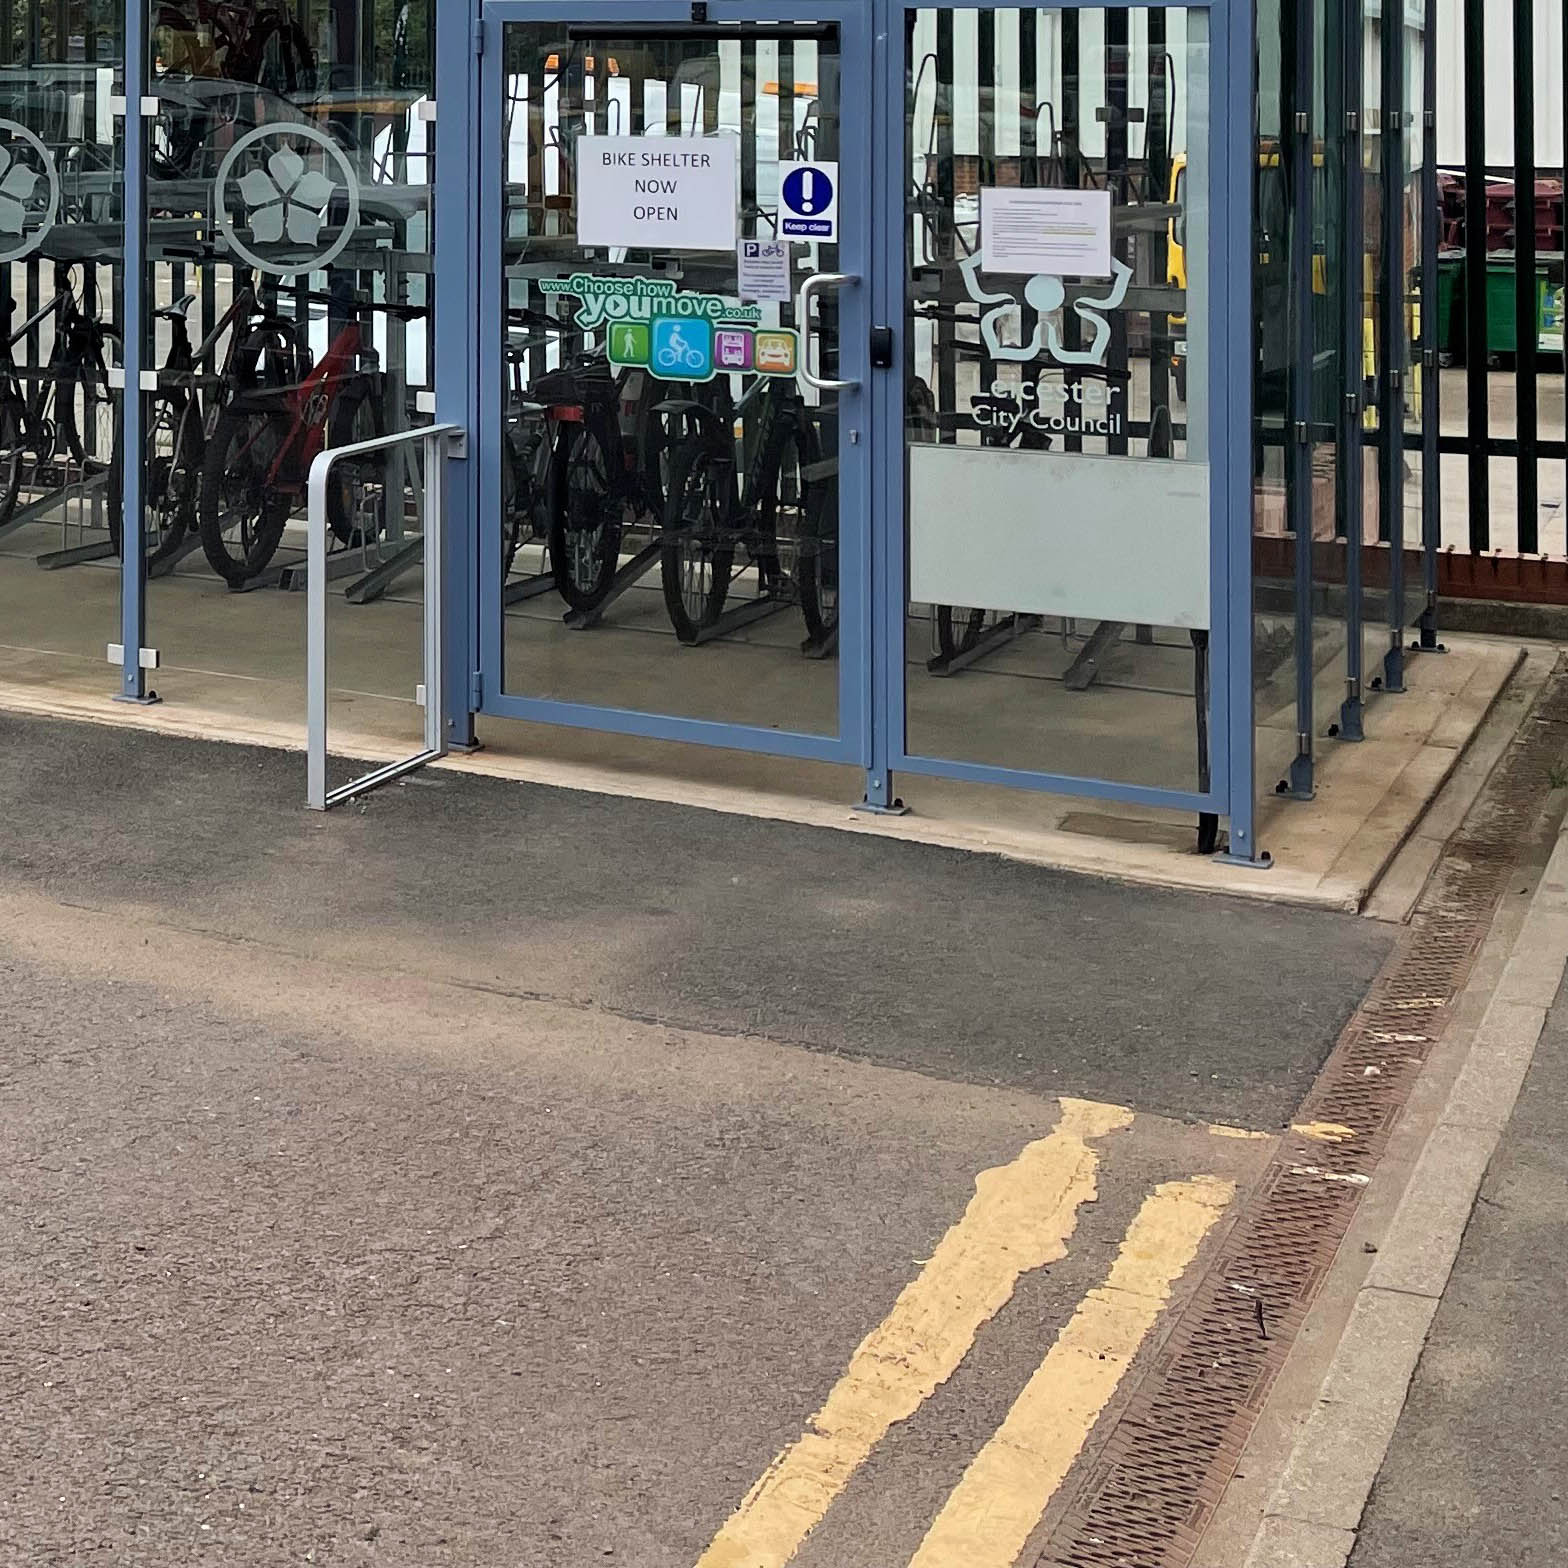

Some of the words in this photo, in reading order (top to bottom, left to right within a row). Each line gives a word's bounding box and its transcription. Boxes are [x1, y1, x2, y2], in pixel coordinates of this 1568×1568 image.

[602, 152, 636, 167] BIKE
[641, 152, 711, 168] SHELTER
[635, 179, 678, 194] NOW
[633, 206, 679, 221] OPEN
[785, 221, 808, 232] Keep
[808, 222, 830, 232] clear
[972, 404, 1020, 433] City
[1029, 408, 1121, 435] Council
